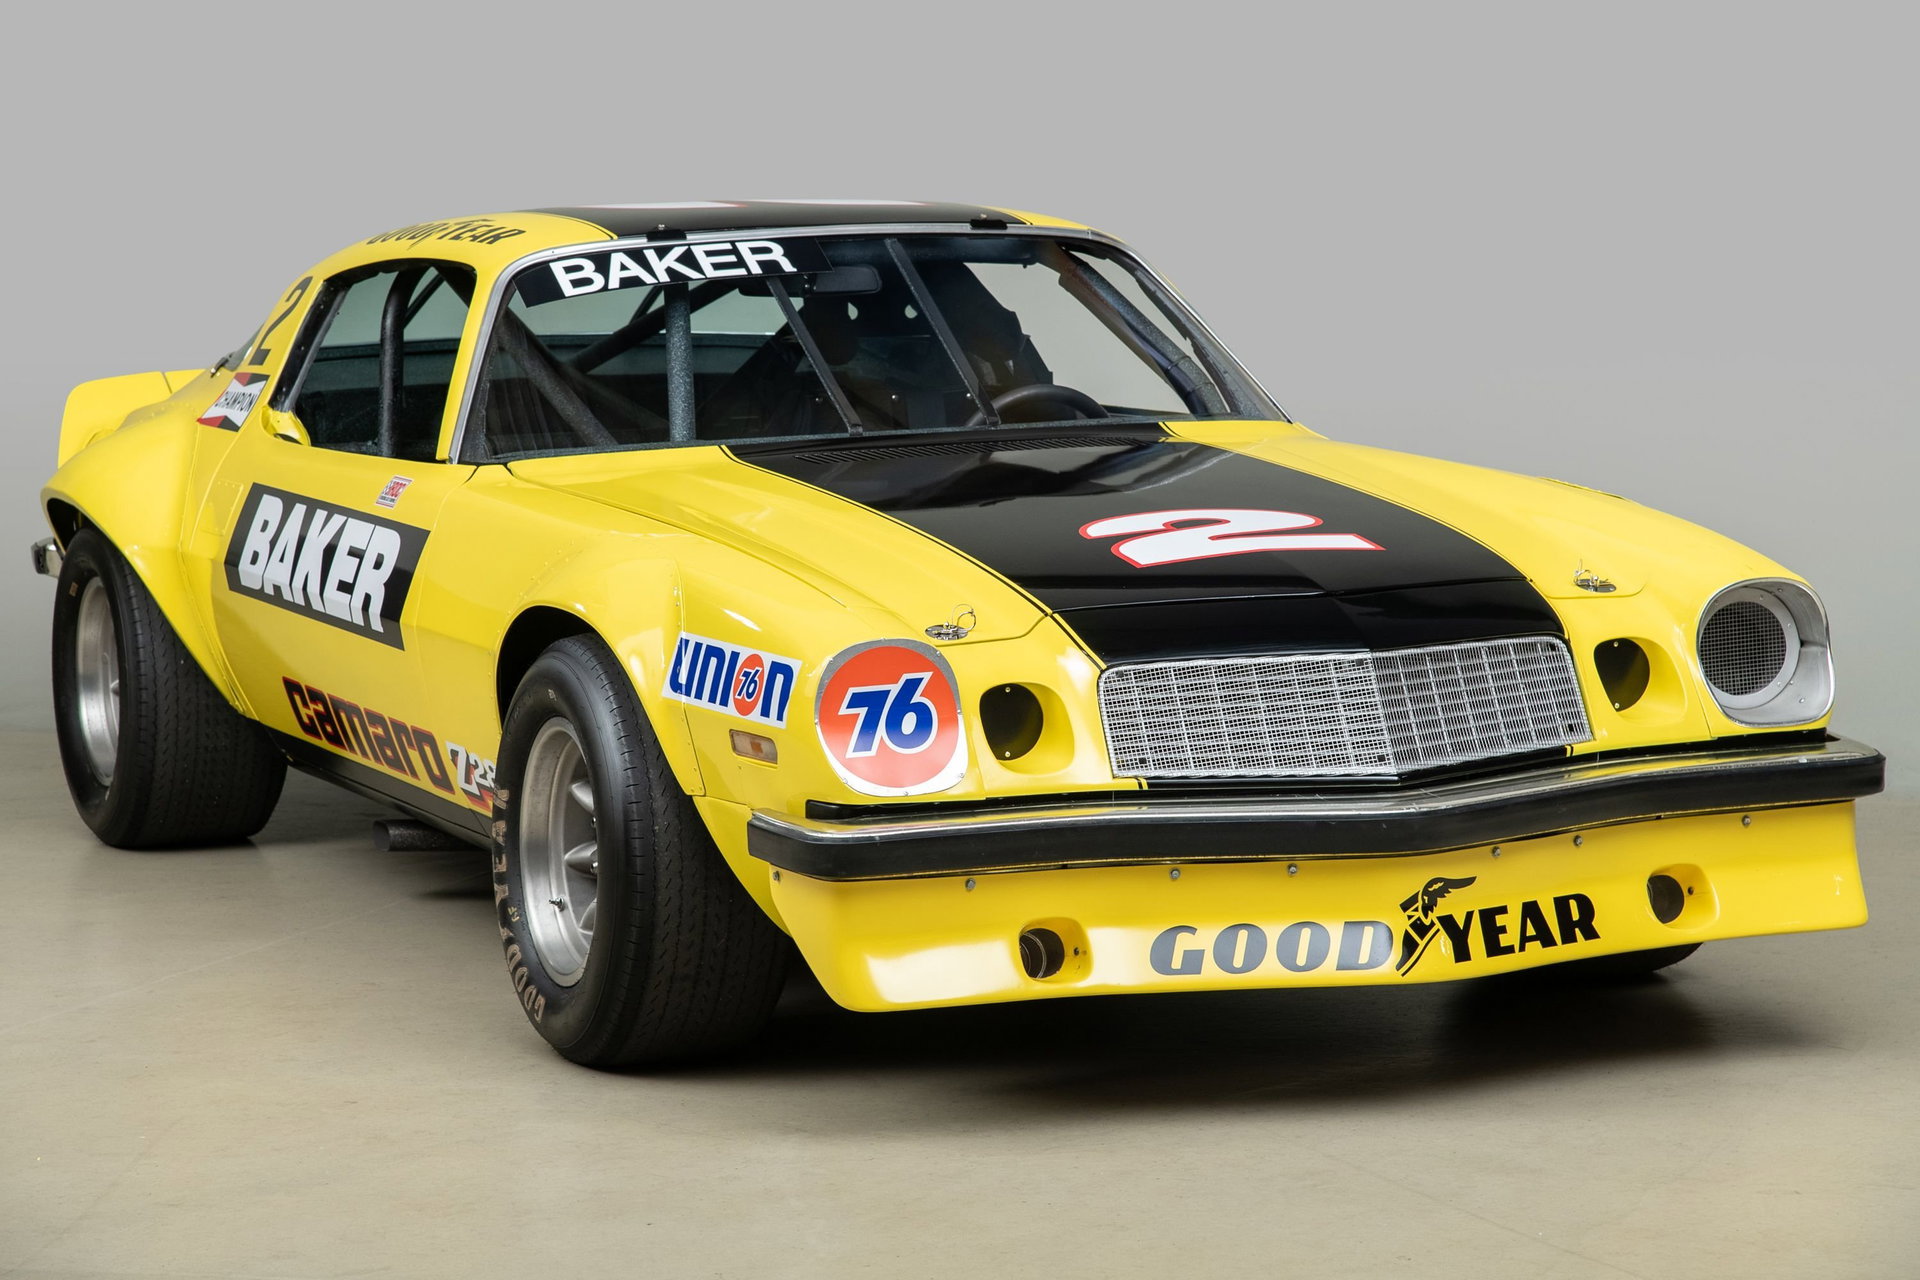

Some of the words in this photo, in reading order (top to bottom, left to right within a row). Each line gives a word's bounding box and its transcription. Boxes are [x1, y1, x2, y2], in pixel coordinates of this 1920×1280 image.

[549, 240, 797, 298] BAKER
[249, 276, 313, 366] 2
[238, 493, 401, 633] BAKER
[1079, 508, 1386, 568] 2
[735, 667, 763, 702] 76
[838, 671, 938, 759] 76
